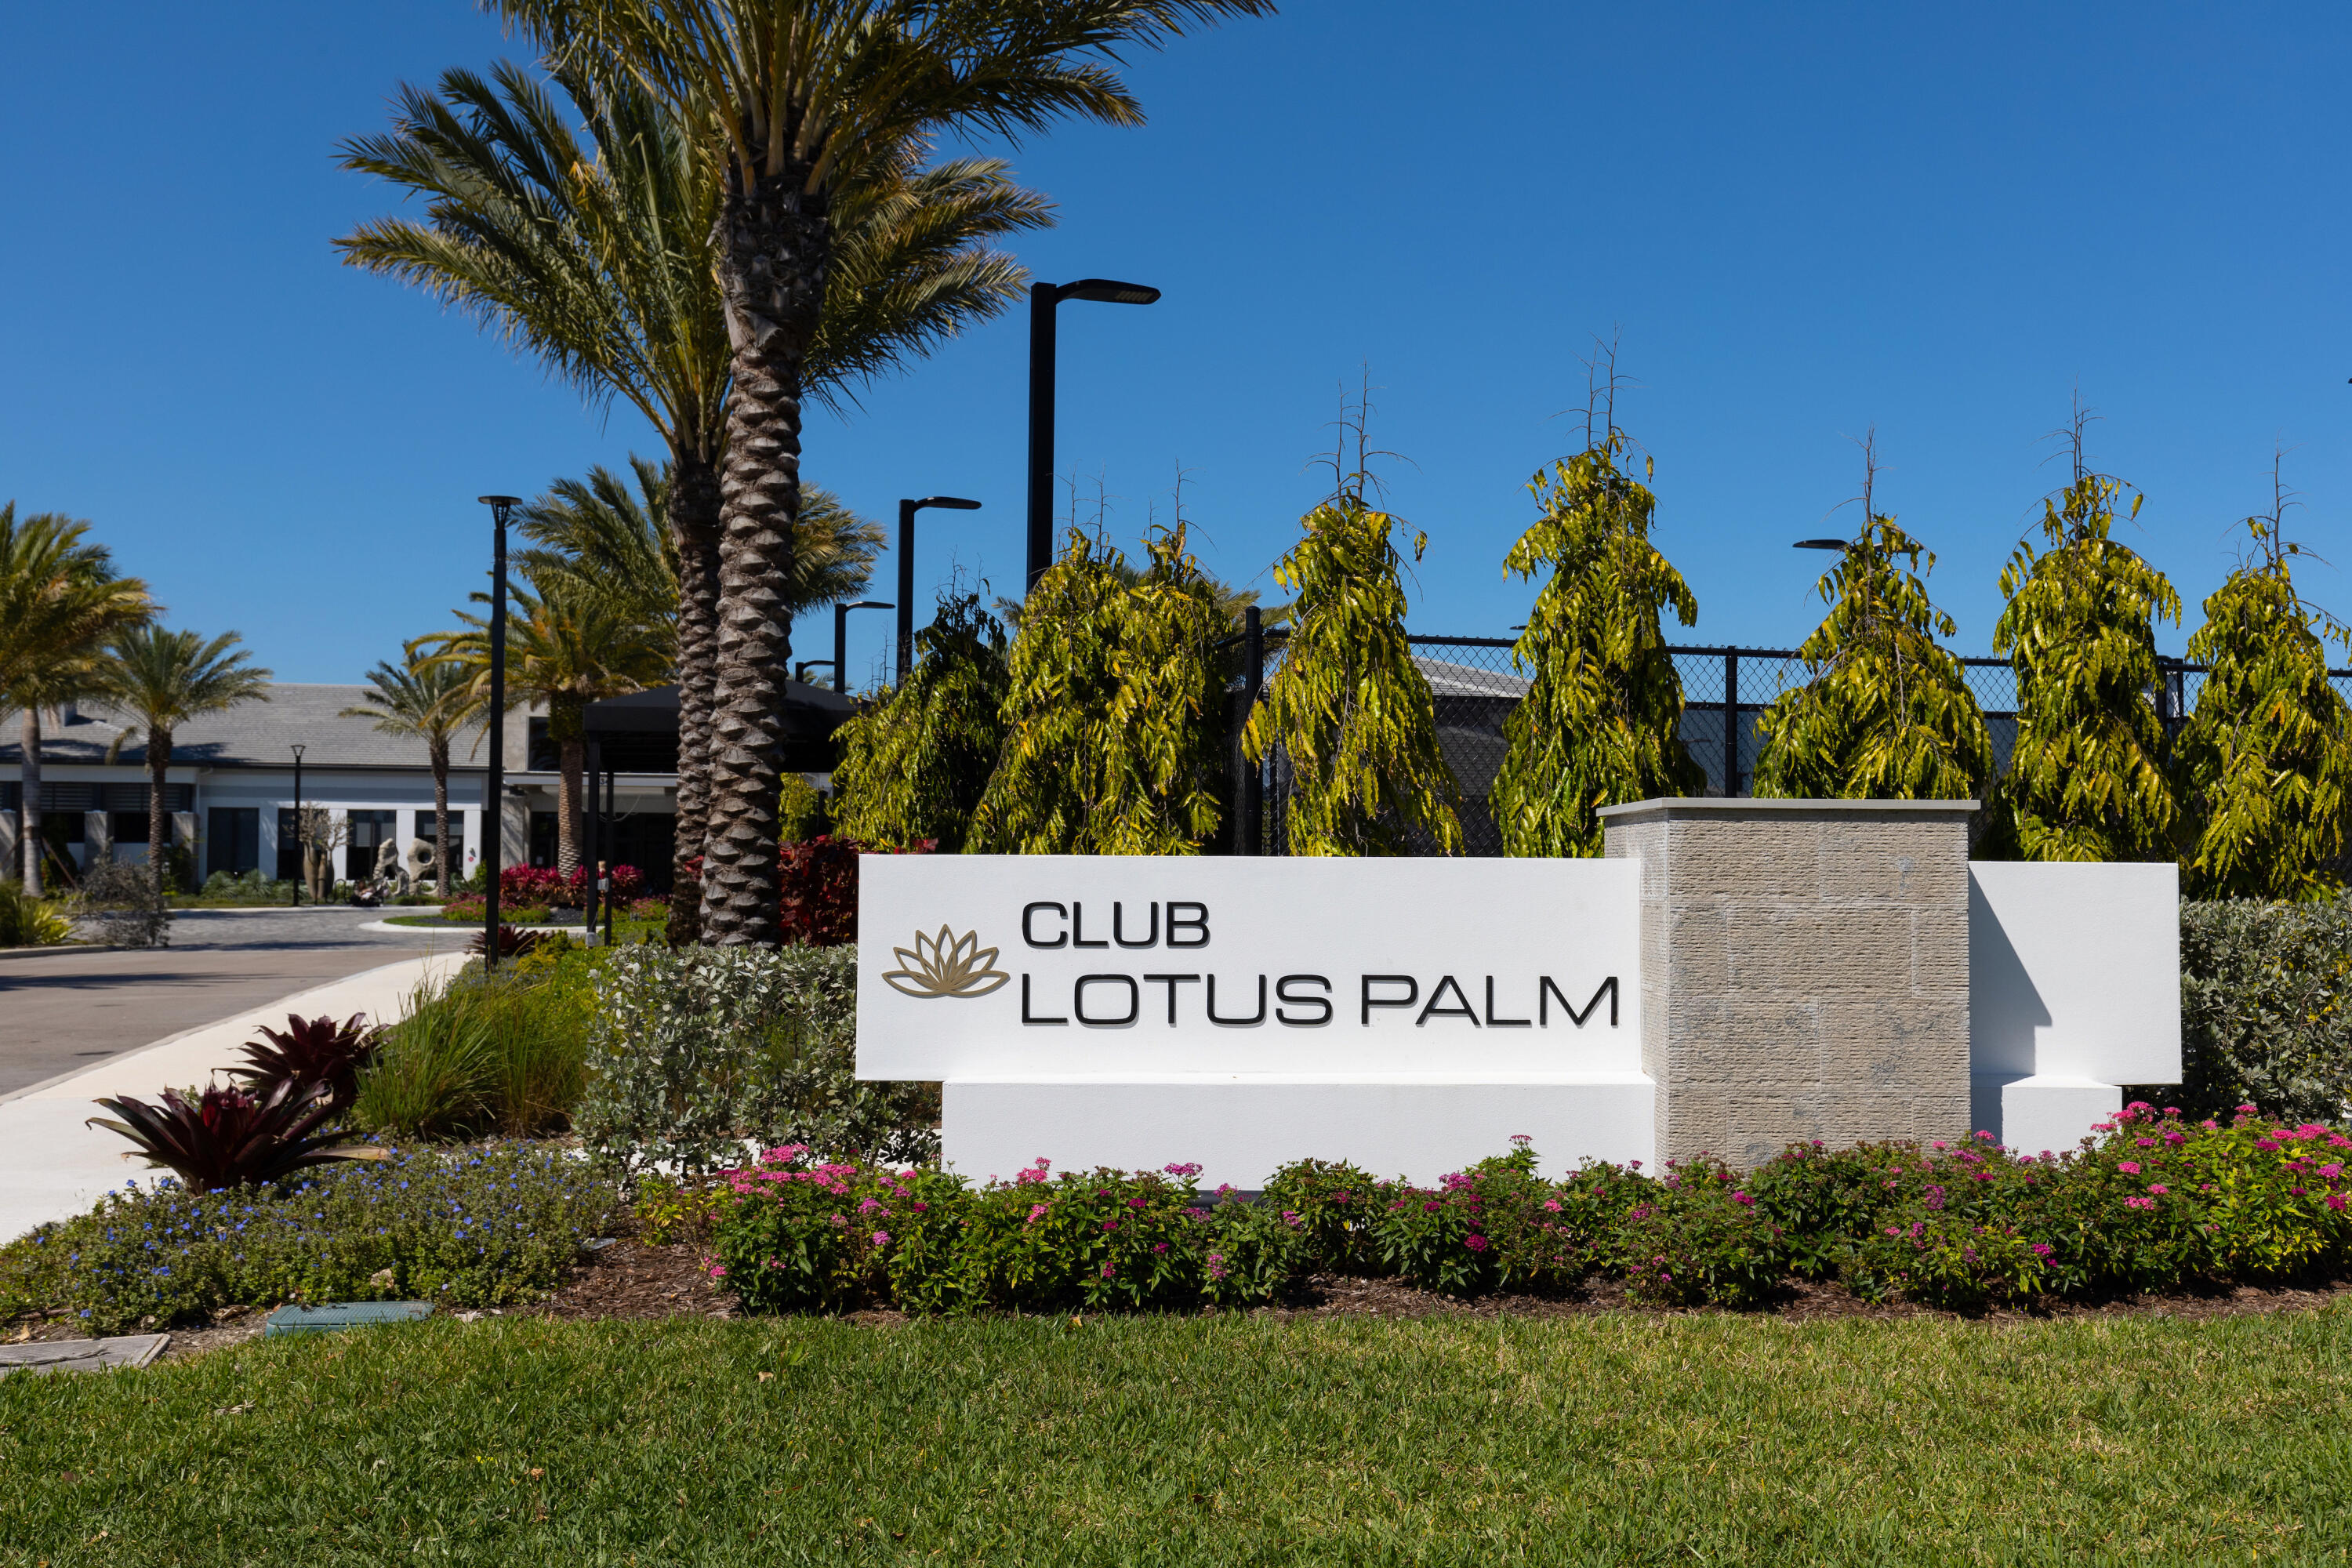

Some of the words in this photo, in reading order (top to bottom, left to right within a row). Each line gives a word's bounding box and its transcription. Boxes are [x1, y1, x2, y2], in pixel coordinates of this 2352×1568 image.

[1022, 901, 1210, 949] CLUB
[1022, 974, 1333, 1025] LOTUS
[1361, 974, 1619, 1026] PALM
